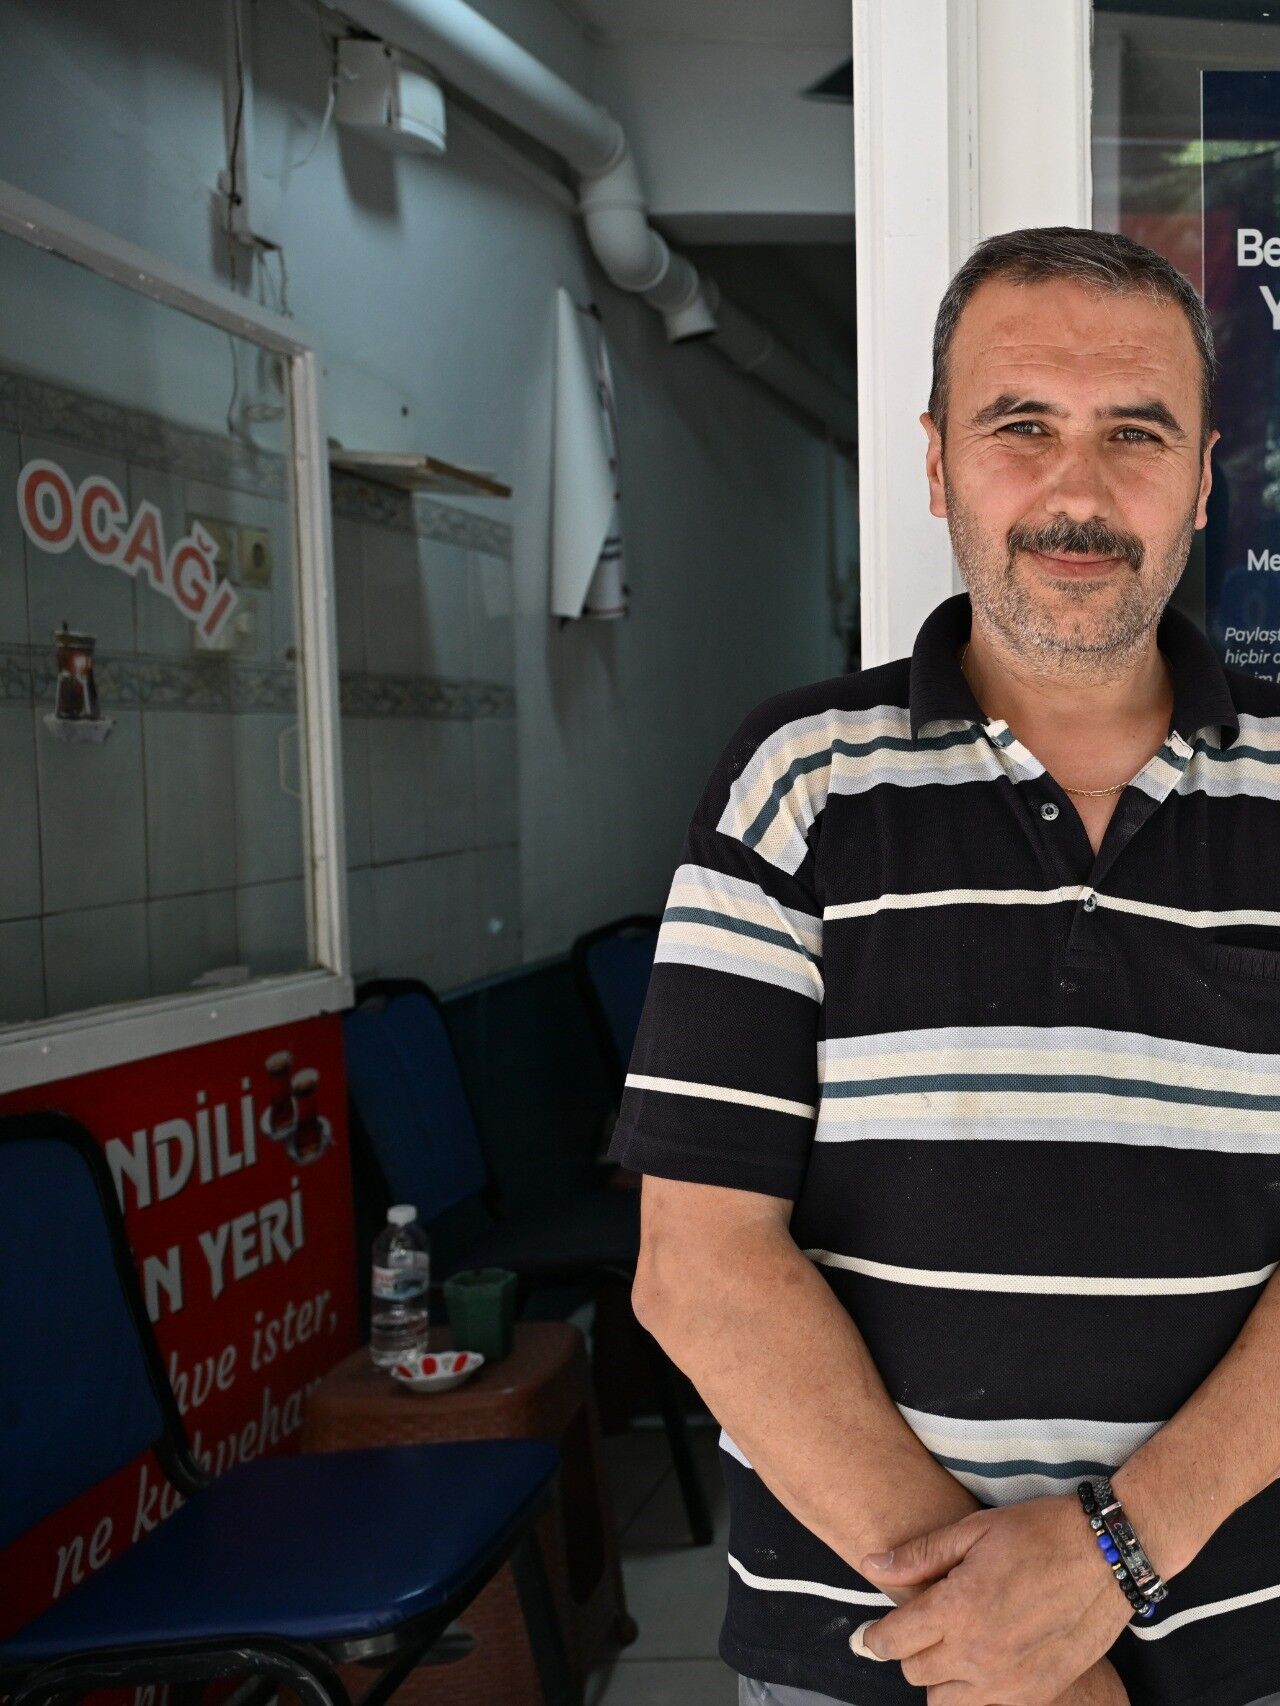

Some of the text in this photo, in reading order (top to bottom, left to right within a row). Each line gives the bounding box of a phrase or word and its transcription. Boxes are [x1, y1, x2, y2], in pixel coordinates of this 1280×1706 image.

[20, 462, 237, 646] OCAĞI
[1224, 649, 1270, 668] hiçbir
[105, 1076, 256, 1216] NDİLİ
[198, 1176, 303, 1300] YERİ
[169, 1290, 337, 1416] hve ister,
[52, 1517, 113, 1598] ne
